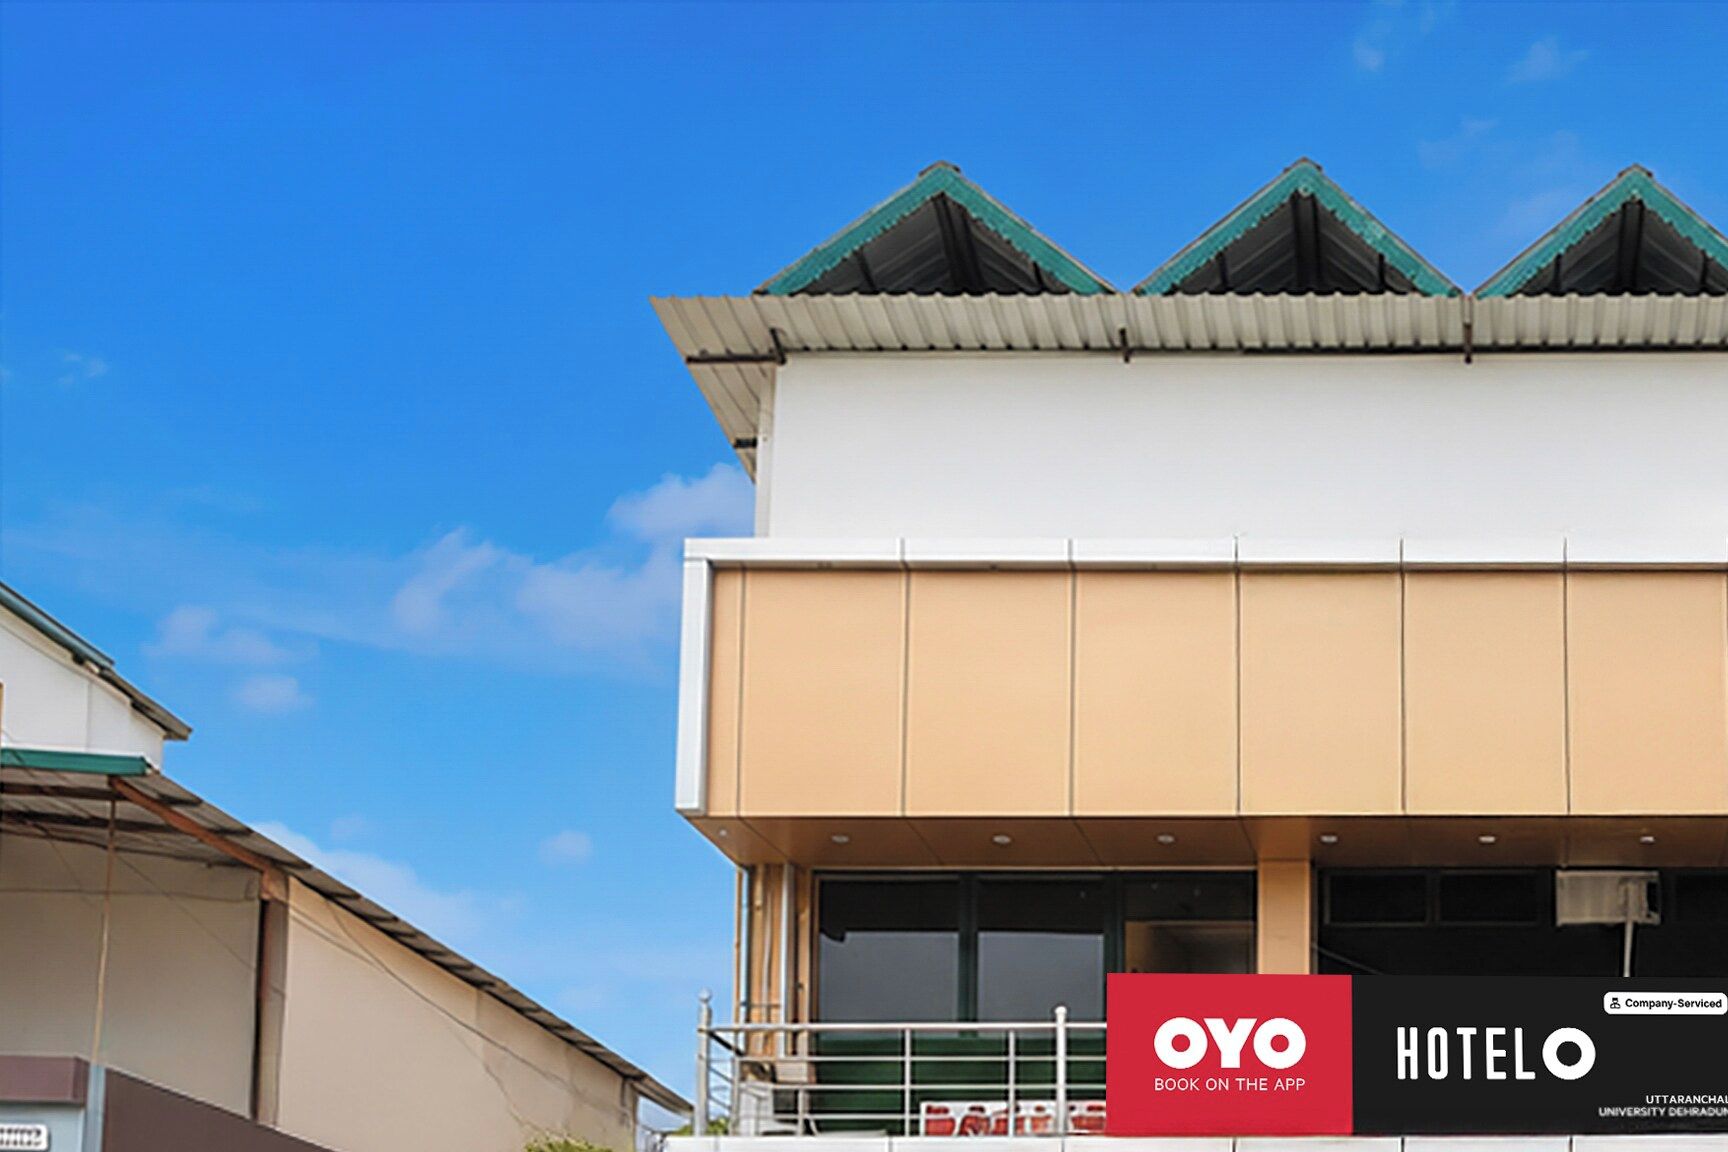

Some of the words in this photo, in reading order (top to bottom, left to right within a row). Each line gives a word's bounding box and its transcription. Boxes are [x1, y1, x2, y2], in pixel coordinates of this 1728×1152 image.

[1625, 998, 1723, 1010] Company-Serviced
[1153, 1016, 1307, 1070] OYO
[1154, 1077, 1200, 1091] BOOK
[1205, 1077, 1229, 1091] ON
[1234, 1077, 1268, 1091] THE
[1273, 1077, 1306, 1091] APP
[1598, 1106, 1666, 1117] UNIVERSITY
